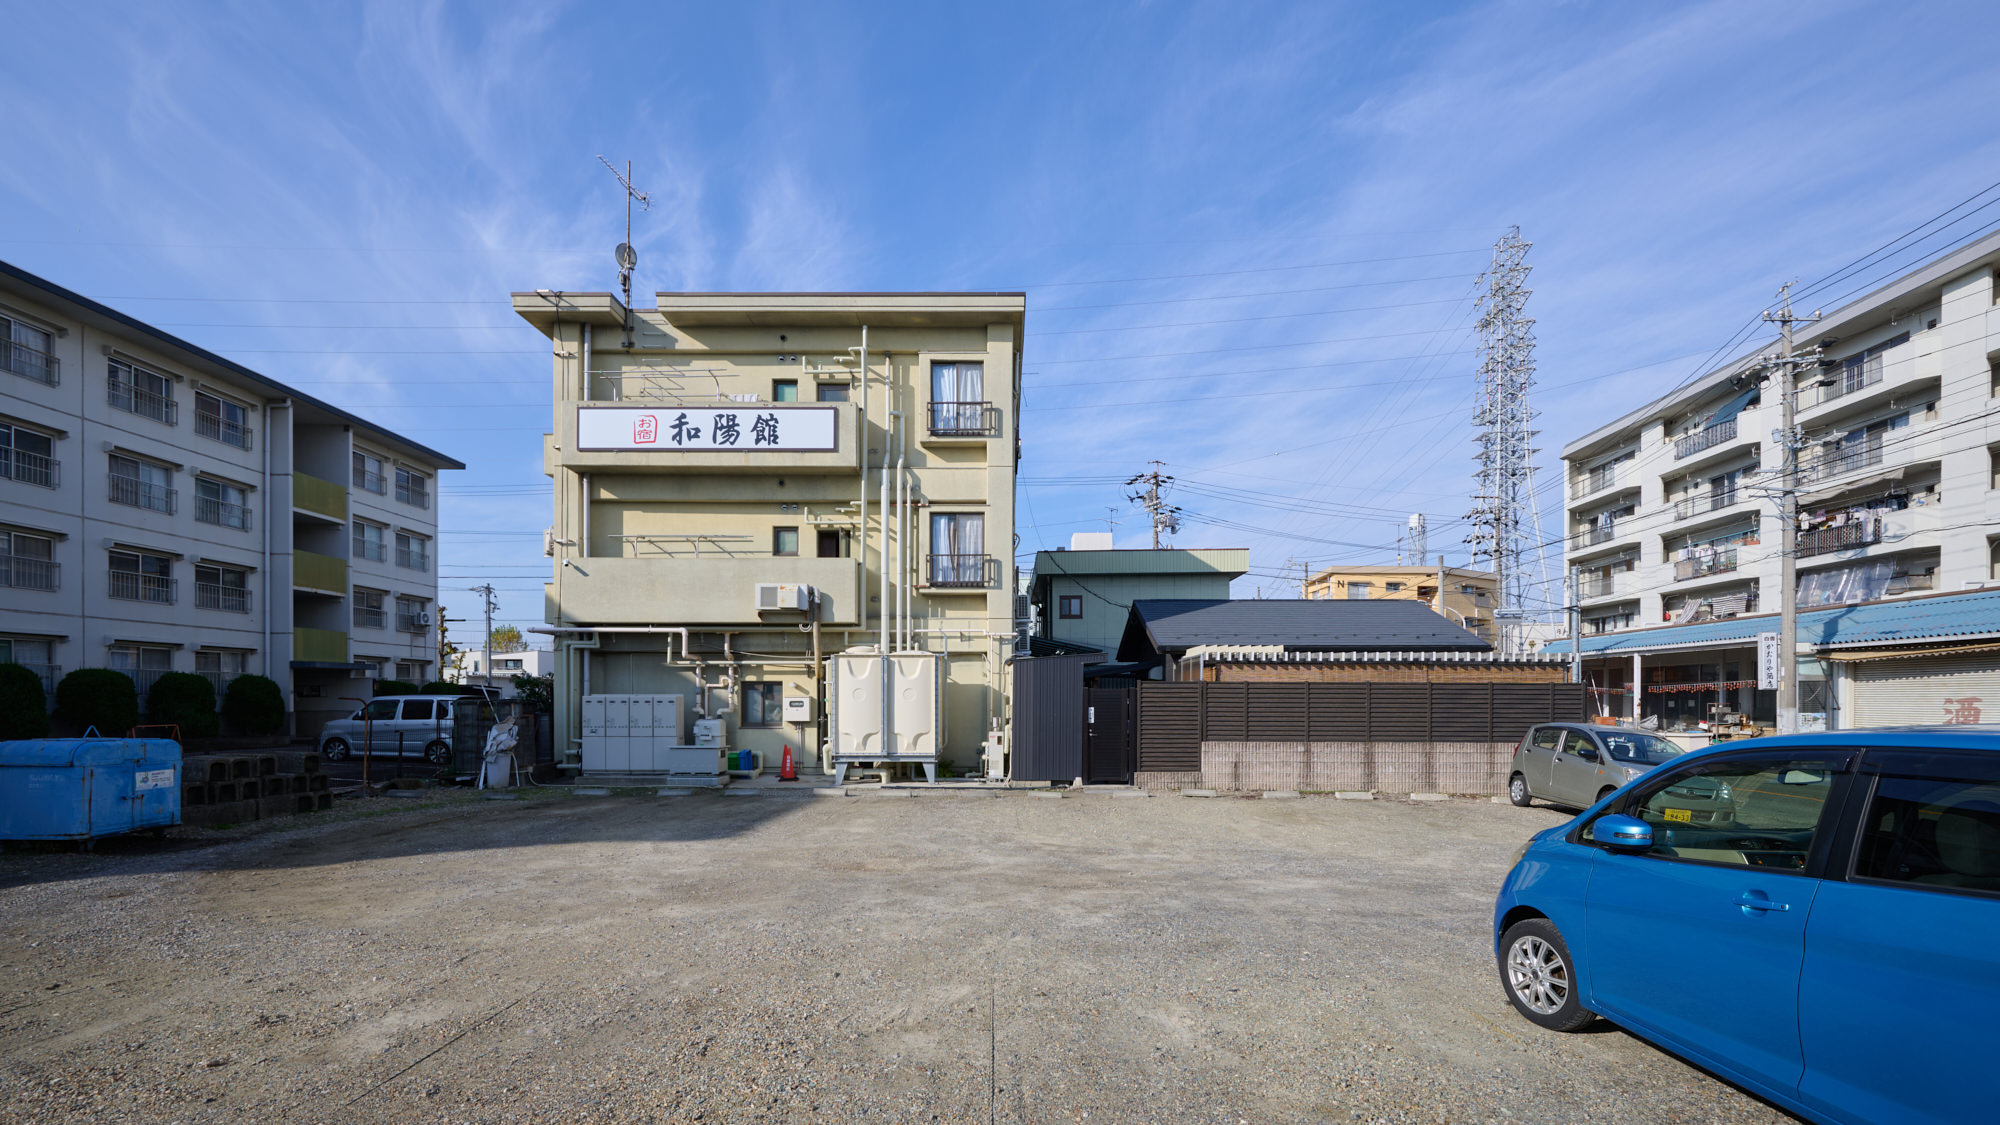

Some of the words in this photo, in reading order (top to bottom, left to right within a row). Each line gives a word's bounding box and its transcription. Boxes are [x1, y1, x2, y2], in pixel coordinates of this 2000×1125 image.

[637, 418, 653, 440] お宿
[669, 412, 779, 446] 和陽館
[1943, 696, 1983, 724] 酒
